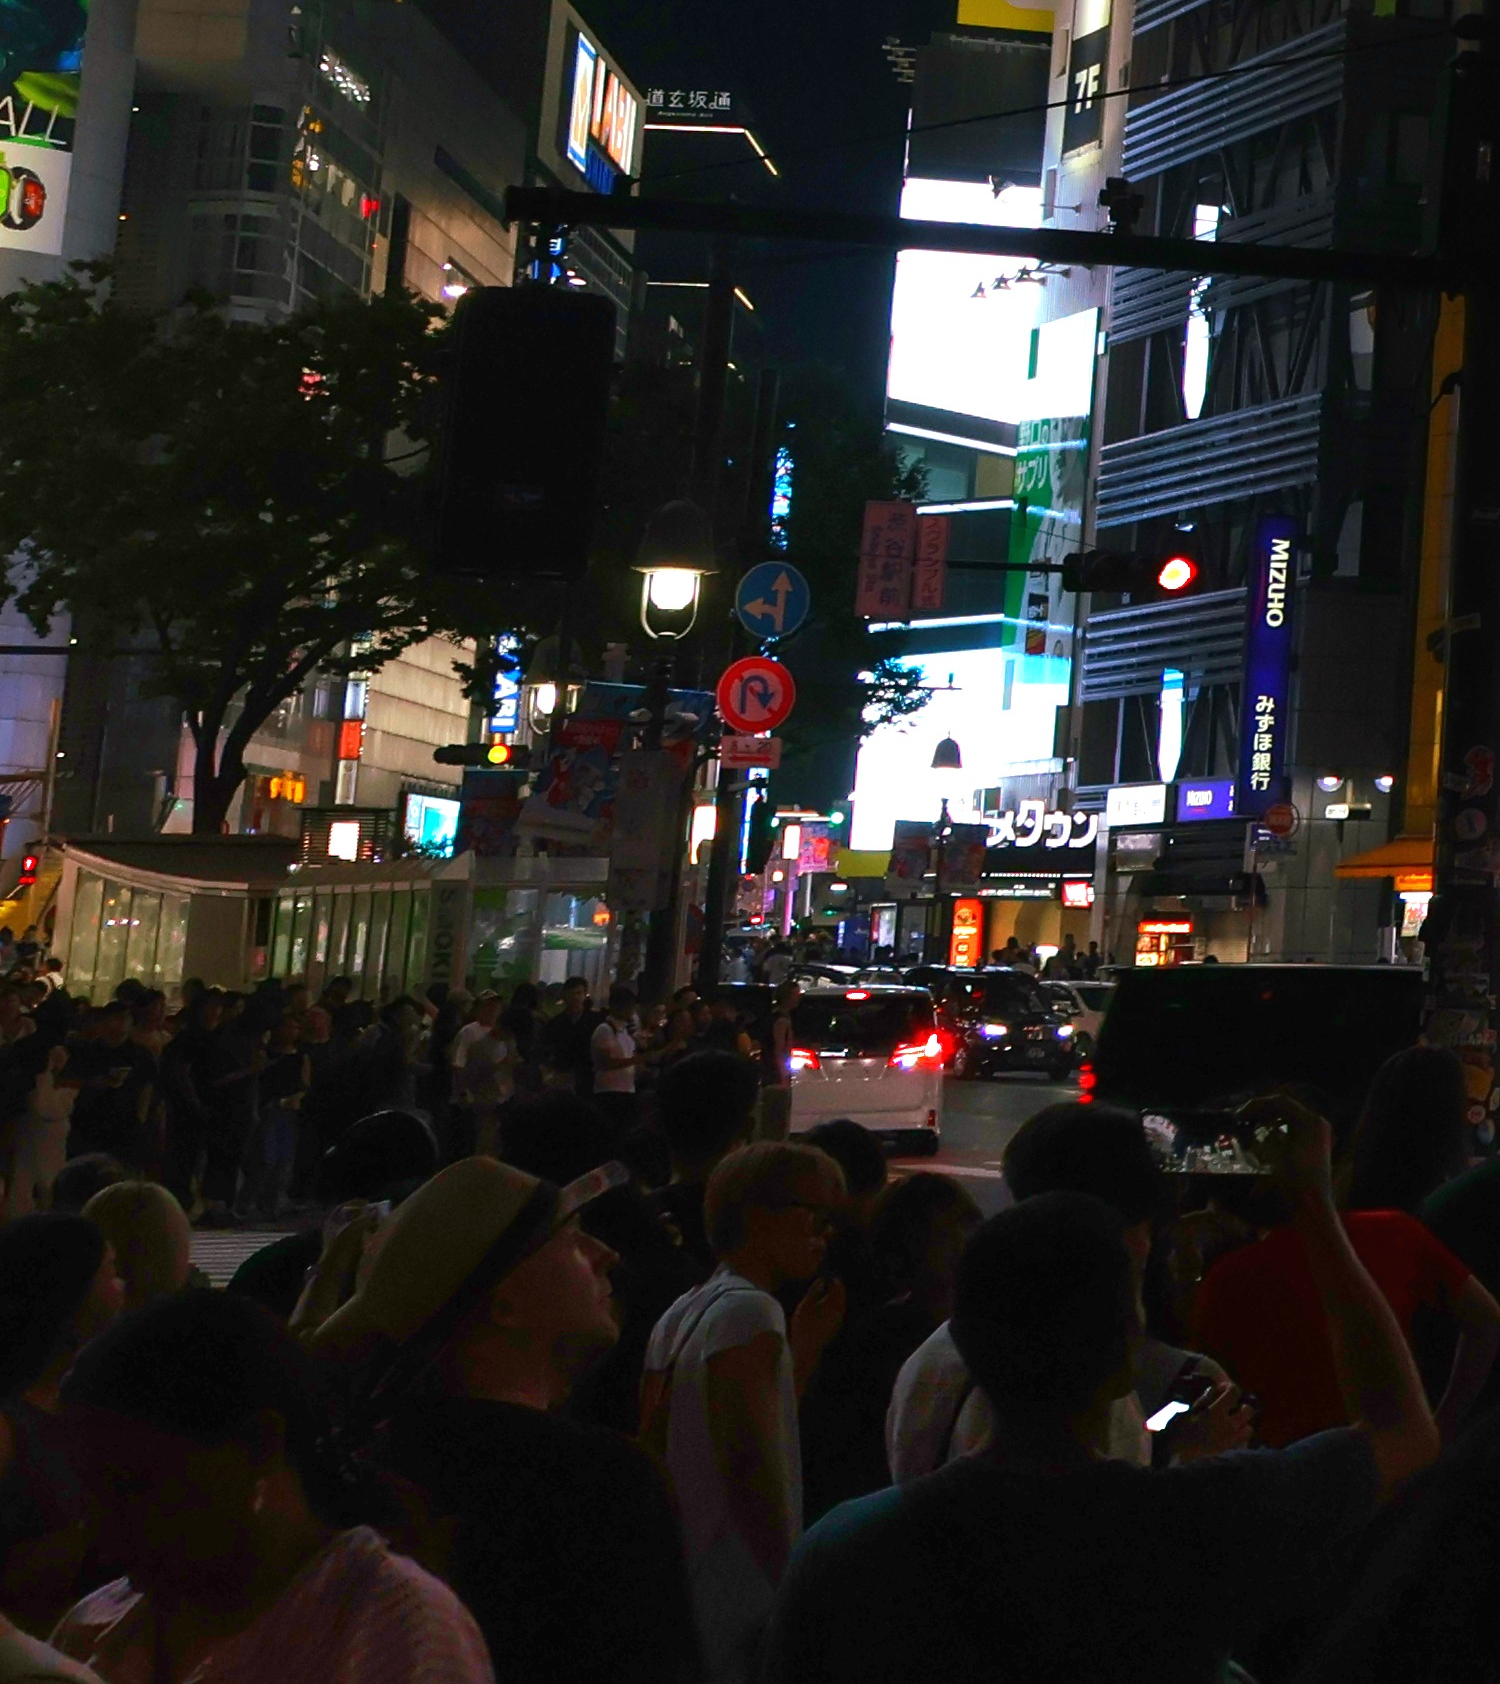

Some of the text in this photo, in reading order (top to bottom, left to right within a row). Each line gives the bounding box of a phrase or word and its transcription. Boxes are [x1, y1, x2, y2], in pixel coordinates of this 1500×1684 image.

[1074, 64, 1101, 114] 7F
[1266, 528, 1290, 628] MIZUHO
[1250, 695, 1276, 792] みずほ銀行
